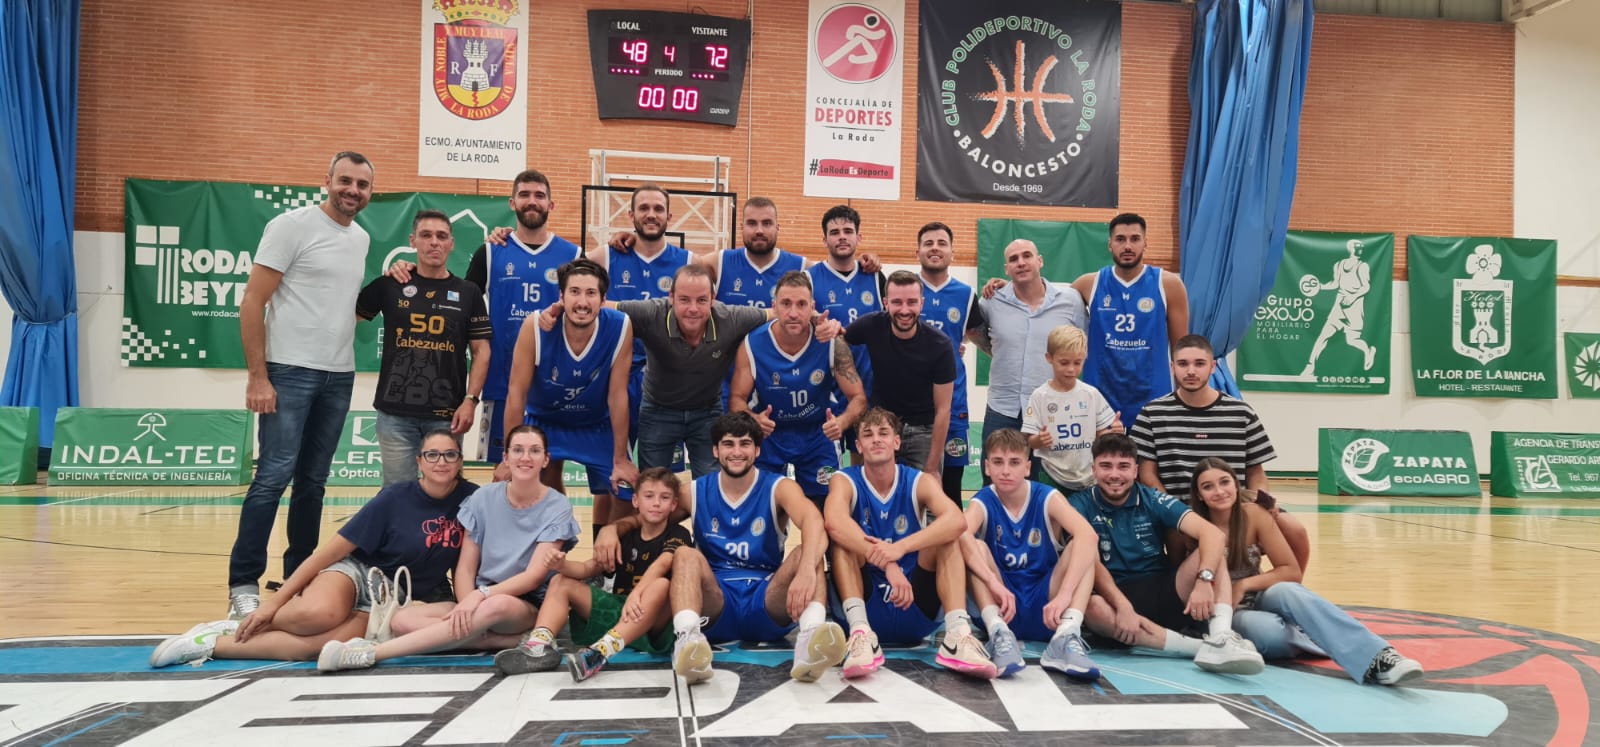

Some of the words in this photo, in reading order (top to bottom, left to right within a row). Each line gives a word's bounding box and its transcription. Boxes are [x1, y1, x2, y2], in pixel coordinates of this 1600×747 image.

[454, 26, 479, 36] MUY
[616, 21, 641, 31] LOCAL
[691, 26, 728, 37] VISITANTE
[622, 41, 648, 63] 48
[945, 15, 1073, 74] POLIDEPORTIVO
[436, 37, 447, 72] NOBLE
[664, 45, 675, 63] 4
[705, 46, 728, 68] 72
[450, 61, 461, 75] R
[1070, 49, 1090, 75] LA
[490, 63, 499, 77] F
[654, 68, 684, 77] PERIODO
[436, 79, 448, 100] MUY
[502, 86, 513, 102] DE
[638, 86, 665, 108] 00
[672, 88, 698, 111] 00
[816, 96, 878, 107] CONCEJALÍA
[881, 100, 892, 108] DE
[941, 79, 960, 126] CLUB
[1076, 79, 1097, 132] RODA
[450, 102, 464, 116] LA
[467, 105, 499, 119] RODA
[815, 107, 893, 127] DEPORTES
[425, 136, 453, 147] ECMO.
[454, 138, 522, 151] AYUNTAMIENTO
[832, 132, 844, 141] La
[848, 132, 875, 142] Roda
[446, 152, 459, 162] DE
[460, 153, 472, 163] LA
[474, 153, 500, 164] RODA
[958, 135, 1081, 178] BALONCESTO
[993, 182, 1020, 192] Desde
[1022, 184, 1043, 193] 1969
[521, 282, 541, 303] 15
[1267, 294, 1313, 308] Grupo
[409, 313, 445, 335] 50
[1114, 313, 1135, 332] 23
[1256, 321, 1311, 329] MOBILIARIO
[395, 336, 455, 353] Cabezuelo
[1416, 369, 1430, 380] LA
[1433, 369, 1464, 380] FLOR
[1465, 369, 1482, 380] DE
[1486, 369, 1503, 380] LA
[1438, 383, 1465, 392] HOTEL
[789, 389, 808, 408] 10
[1056, 422, 1082, 439] 50
[1513, 438, 1555, 448] AGENCIA
[1556, 439, 1569, 448] DE
[60, 444, 237, 465] INDAL-TEC
[1547, 454, 1587, 465] GERARDO
[1393, 456, 1468, 469] ZAPATA
[57, 472, 100, 481] OFICINA
[104, 469, 149, 481] TÉCNICA
[152, 472, 167, 481] DE
[170, 469, 232, 481] INGENIERÍA
[338, 466, 381, 480] Óptica
[1393, 473, 1471, 485] ecoAGRO
